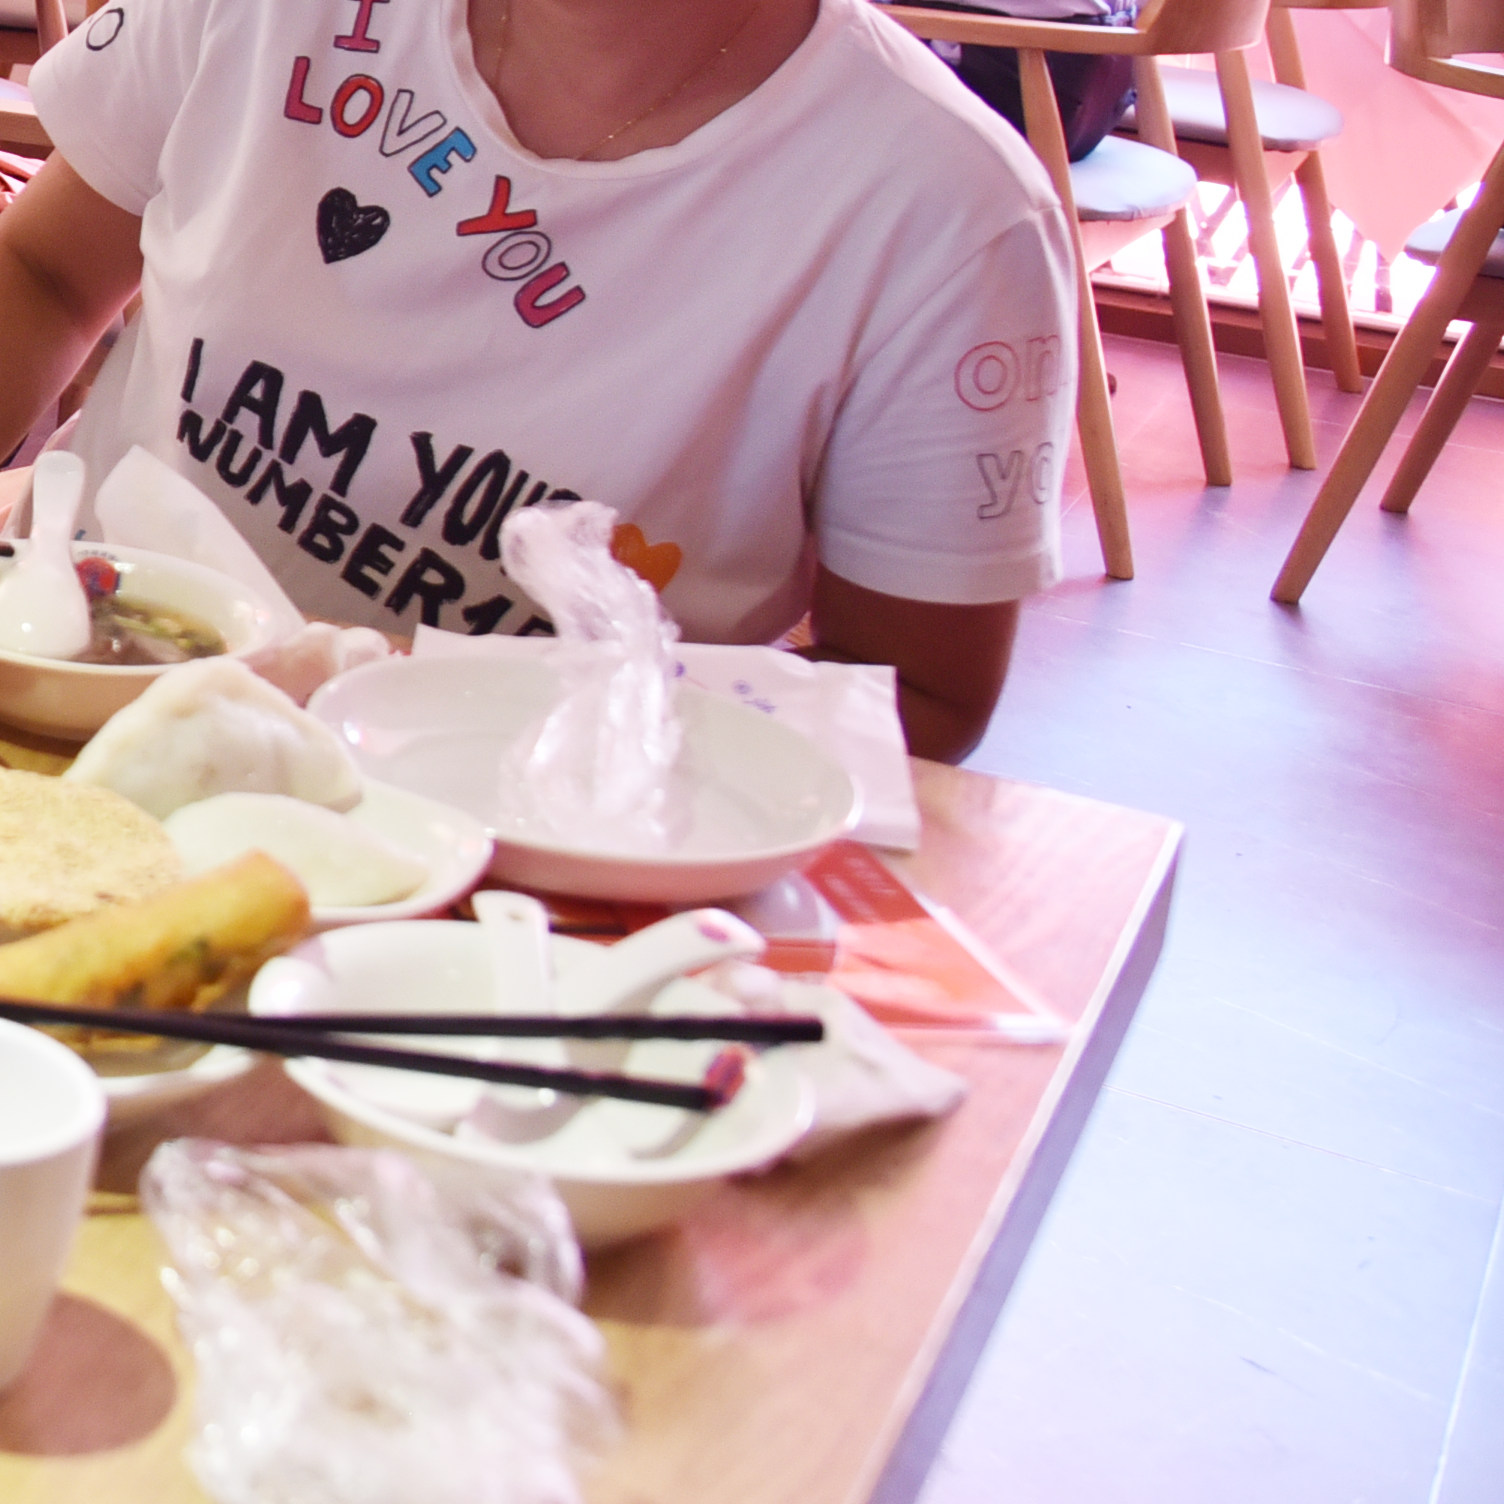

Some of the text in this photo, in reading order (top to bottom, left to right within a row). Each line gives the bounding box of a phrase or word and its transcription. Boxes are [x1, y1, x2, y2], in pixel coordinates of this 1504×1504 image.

[284, 56, 478, 197] LOVE
[456, 175, 587, 329] YOU
[181, 337, 584, 562] I AM YOU
